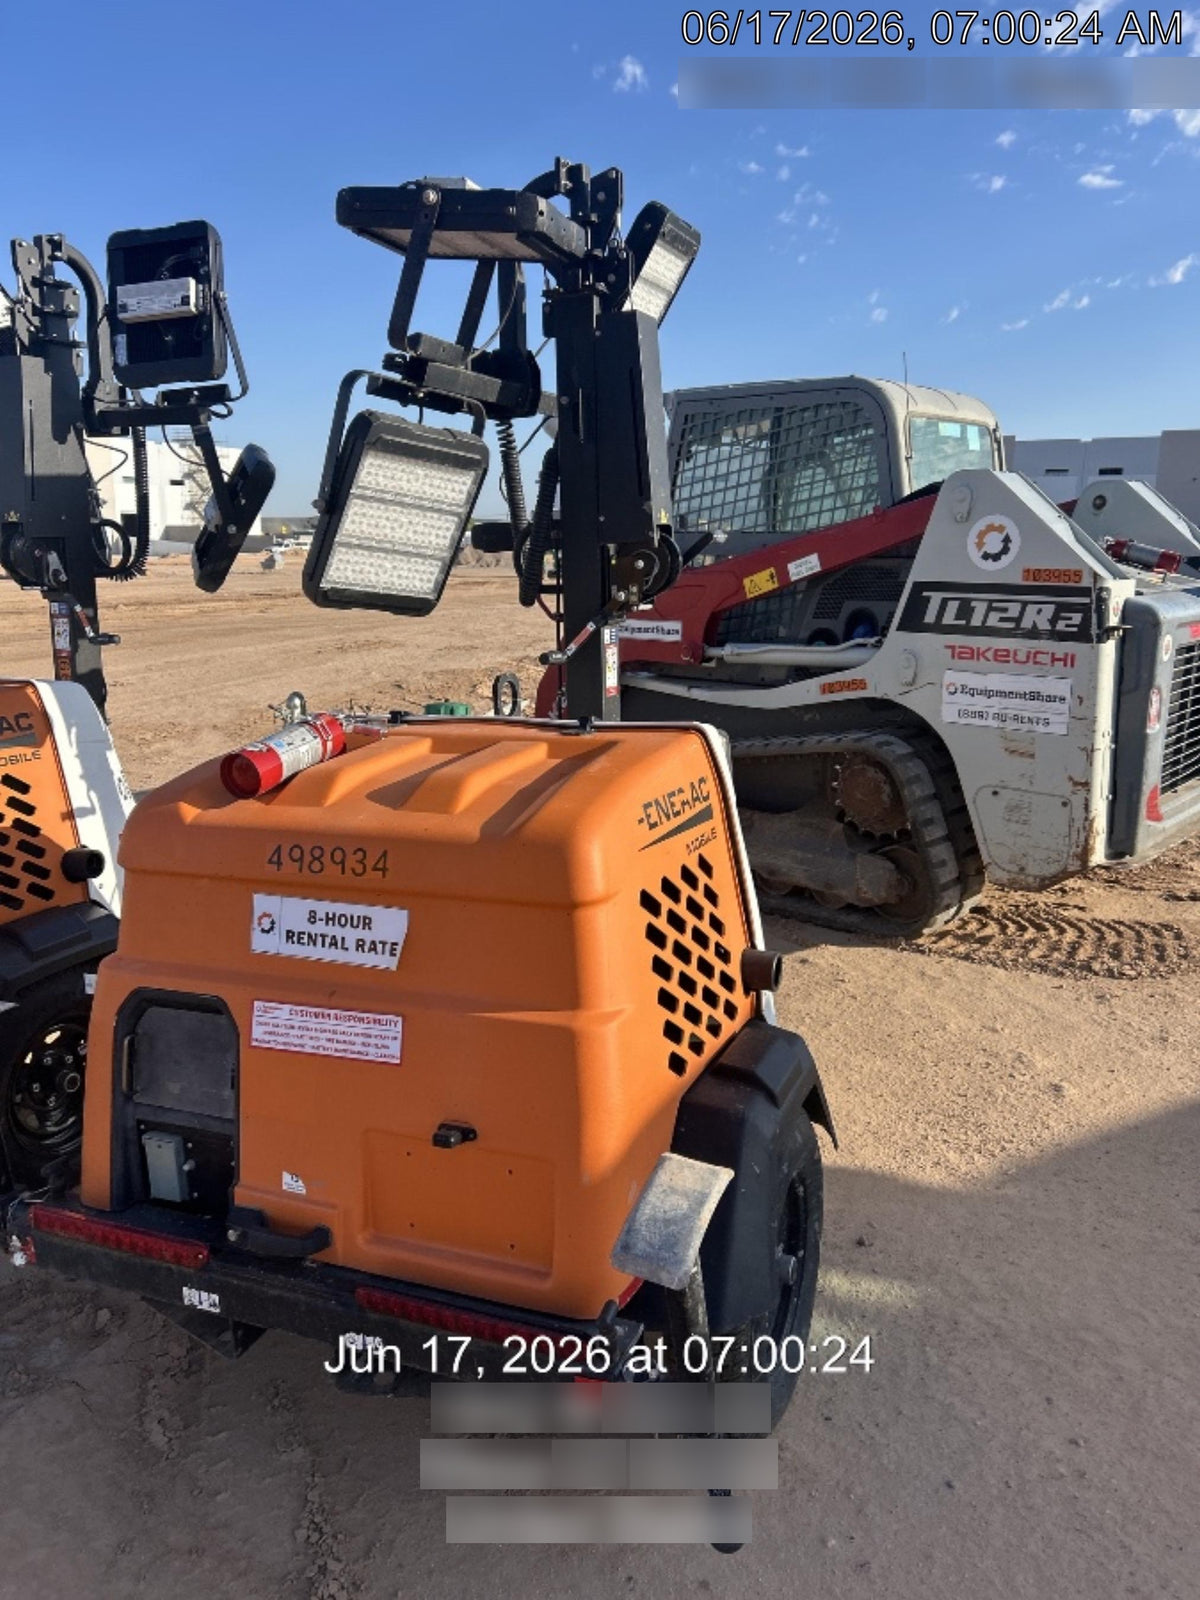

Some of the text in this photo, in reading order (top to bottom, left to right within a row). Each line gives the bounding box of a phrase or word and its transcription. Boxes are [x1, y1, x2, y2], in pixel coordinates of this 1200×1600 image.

[1023, 568, 1083, 584] 103955
[960, 683, 1067, 705] EquipmentShare
[267, 843, 389, 879] 498934
[307, 909, 373, 931] 8-HOUR
[285, 929, 399, 958] RENTAL RATE
